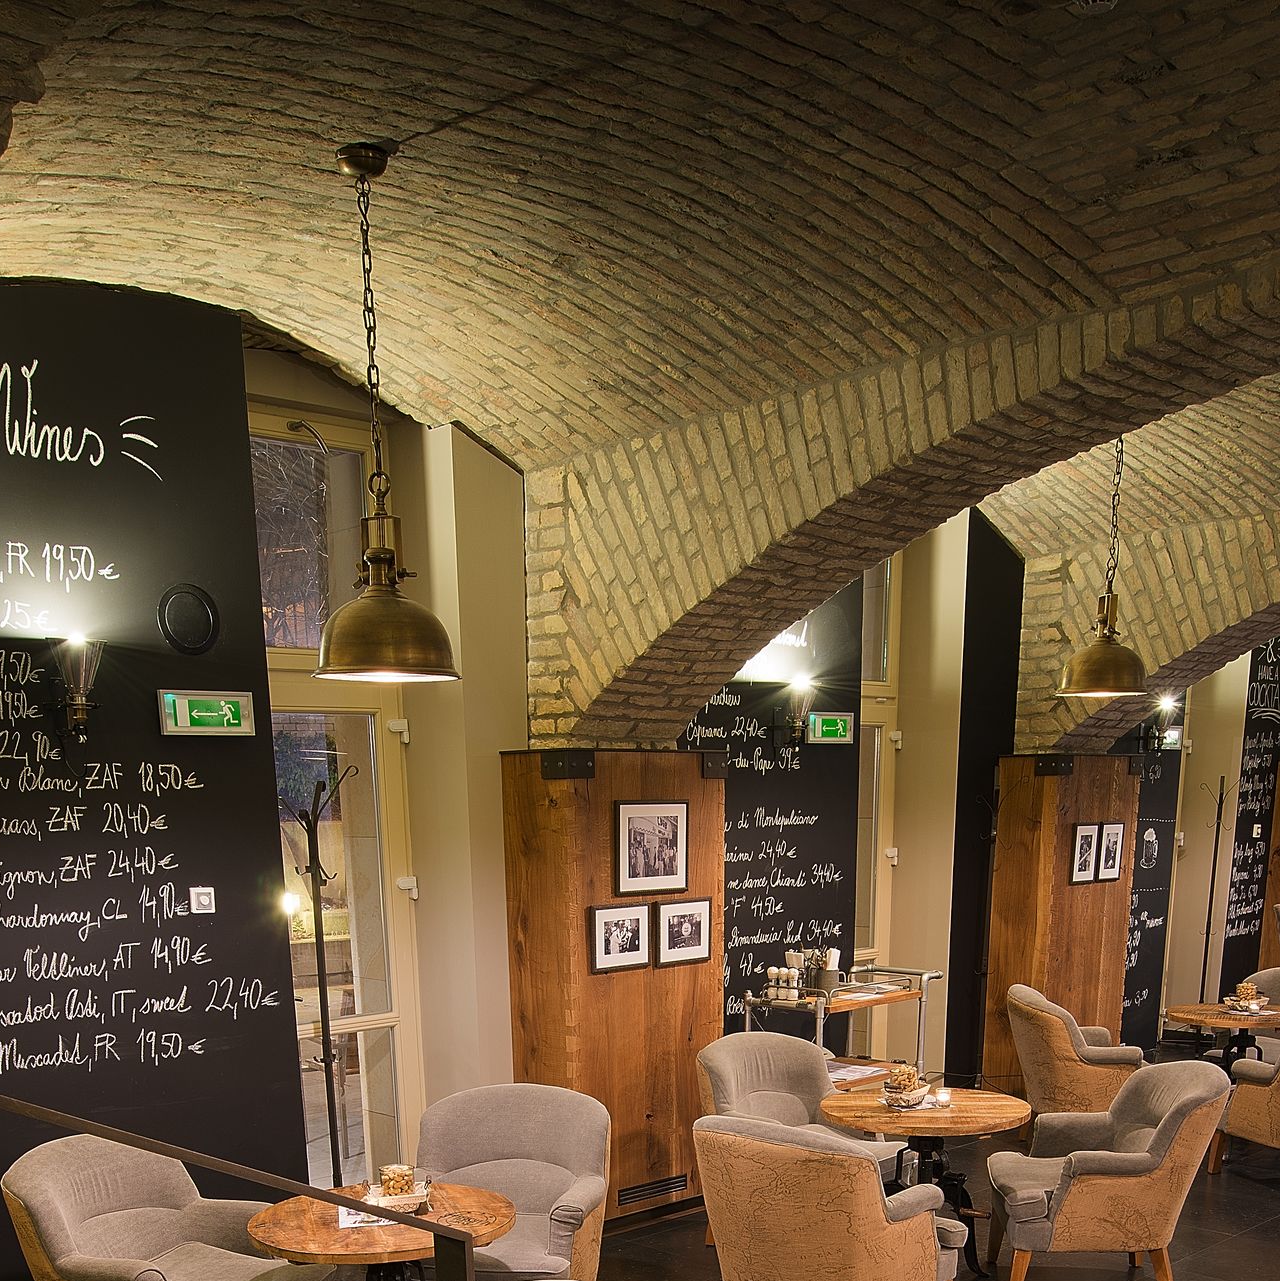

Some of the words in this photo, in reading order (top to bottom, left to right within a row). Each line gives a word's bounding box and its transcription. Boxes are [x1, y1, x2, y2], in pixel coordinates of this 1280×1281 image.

[6, 541, 35, 578] FR
[84, 762, 124, 791] ZAF
[45, 805, 87, 832] ZAF
[58, 853, 98, 883] ZAF
[101, 897, 129, 921] CL
[112, 942, 141, 971] AT
[93, 1032, 121, 1061] FR
